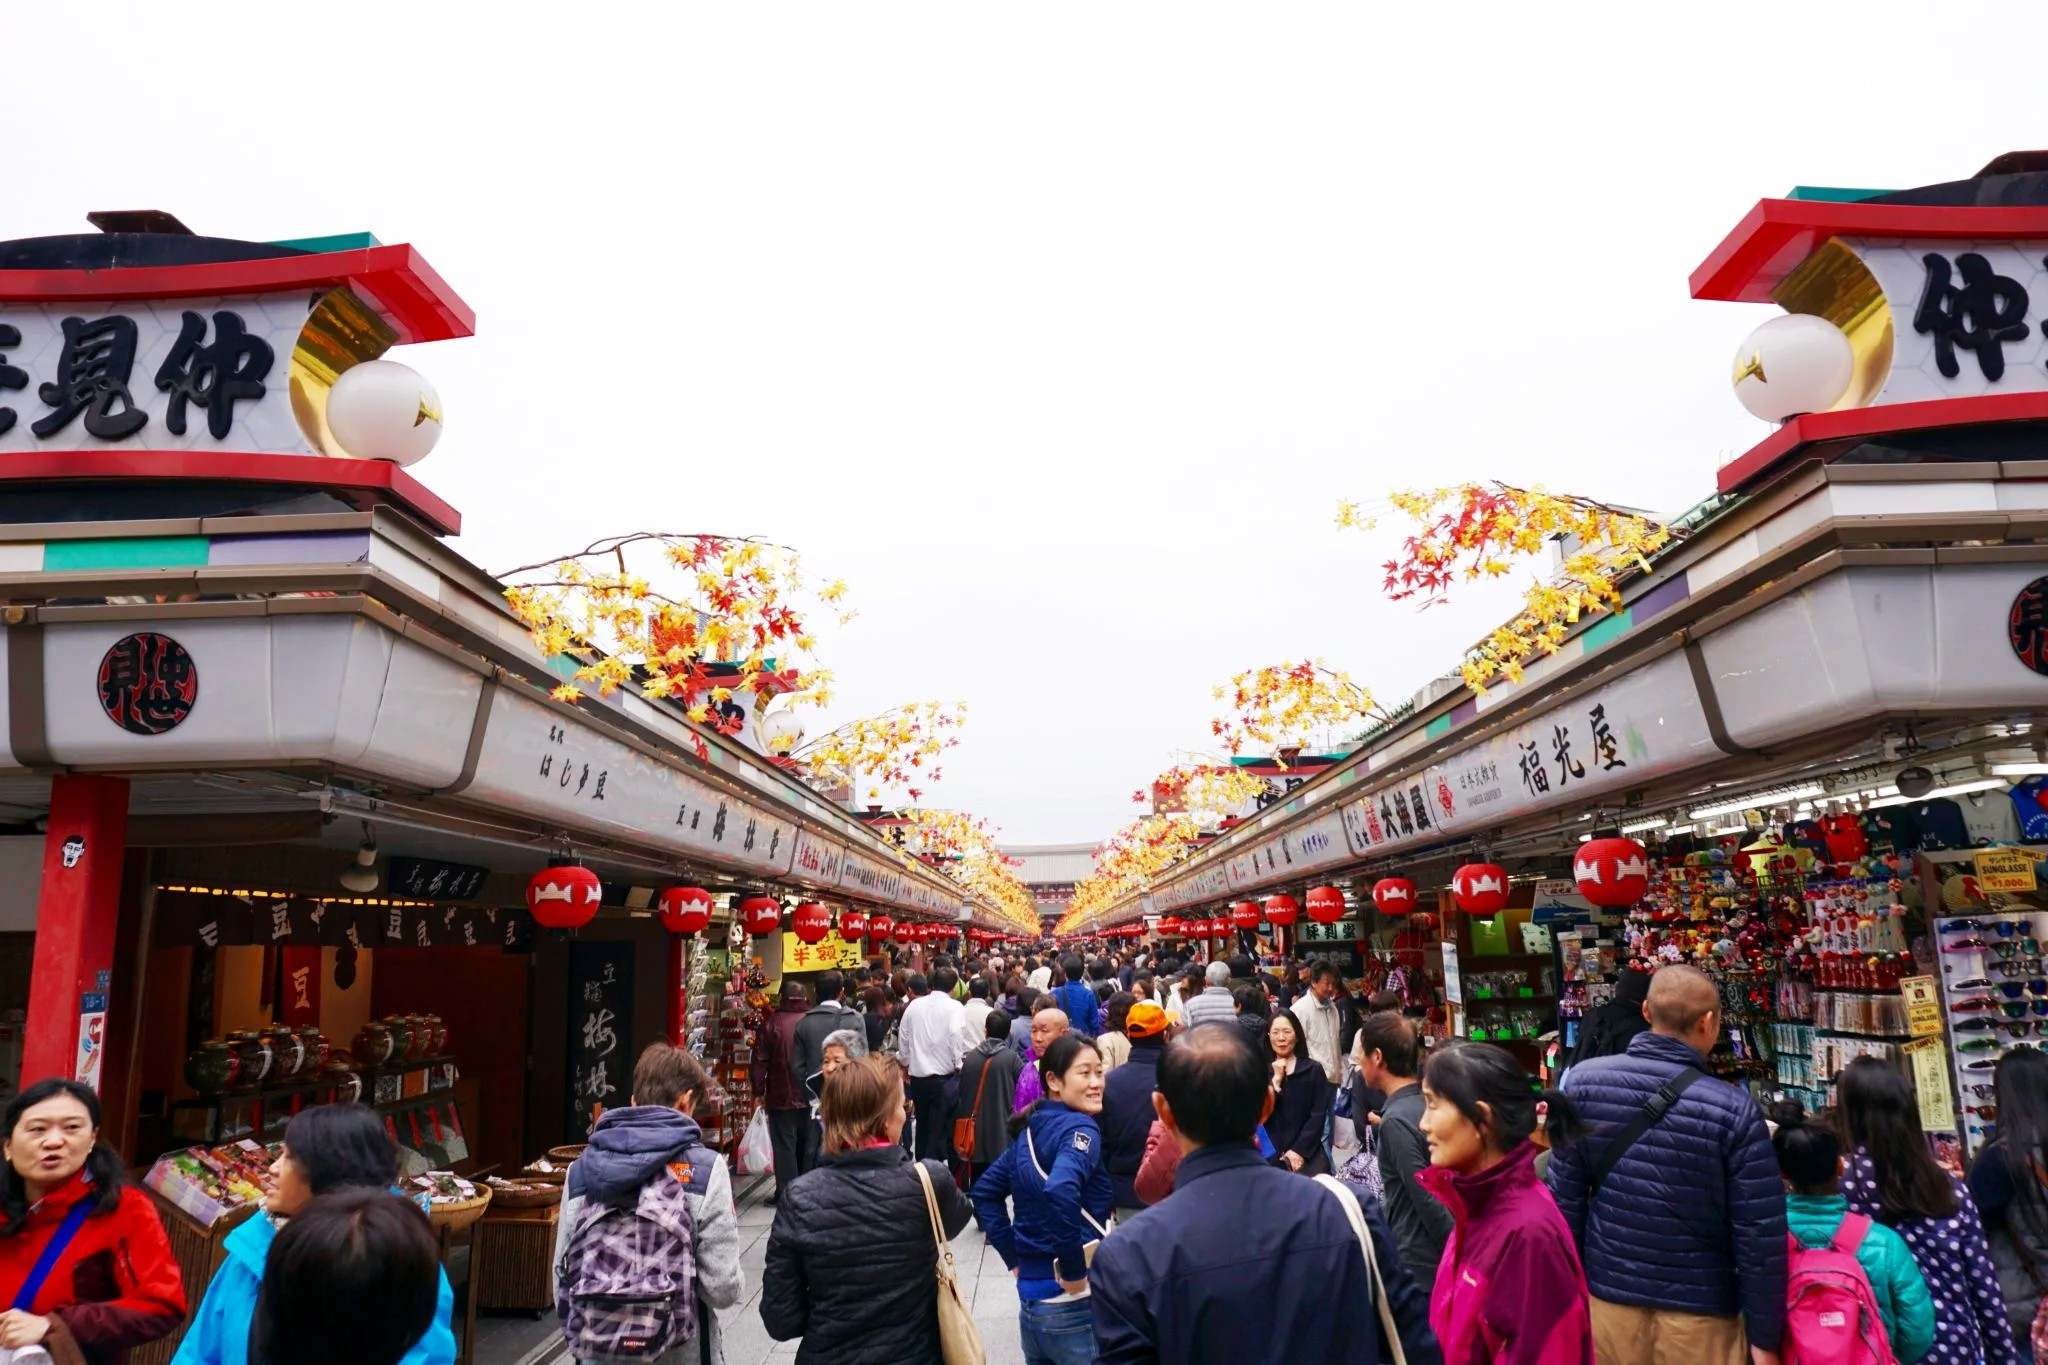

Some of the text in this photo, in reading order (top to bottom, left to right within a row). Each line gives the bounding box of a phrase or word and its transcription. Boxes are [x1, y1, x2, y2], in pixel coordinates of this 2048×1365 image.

[1519, 703, 1626, 797] 福光屋
[292, 966, 310, 1009] 豆
